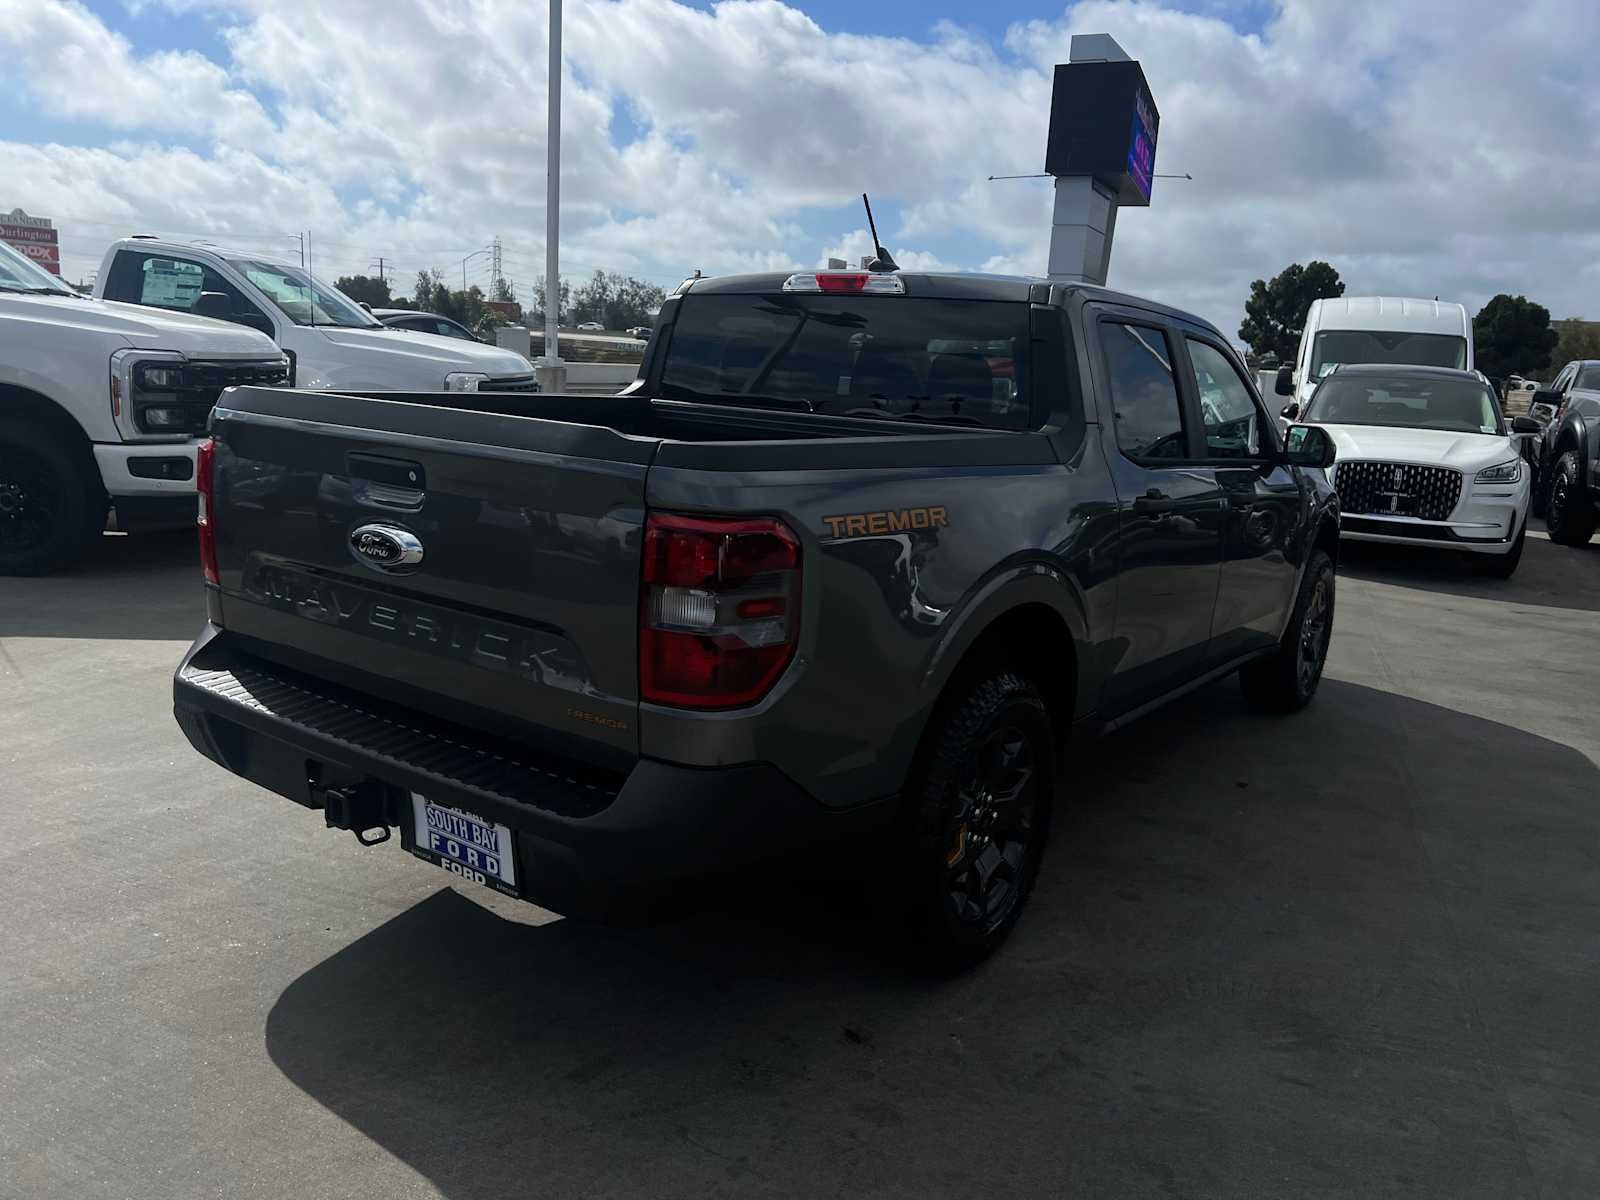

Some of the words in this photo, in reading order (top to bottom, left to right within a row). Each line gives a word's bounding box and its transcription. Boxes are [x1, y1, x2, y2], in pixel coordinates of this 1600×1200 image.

[822, 507, 948, 538] TREMOR
[358, 533, 389, 558] Ford
[263, 574, 559, 670] MAVERICK
[426, 806, 469, 841] SOUTH
[471, 823, 498, 852] BAY
[431, 832, 498, 874] FORD
[441, 858, 486, 885] FORD
